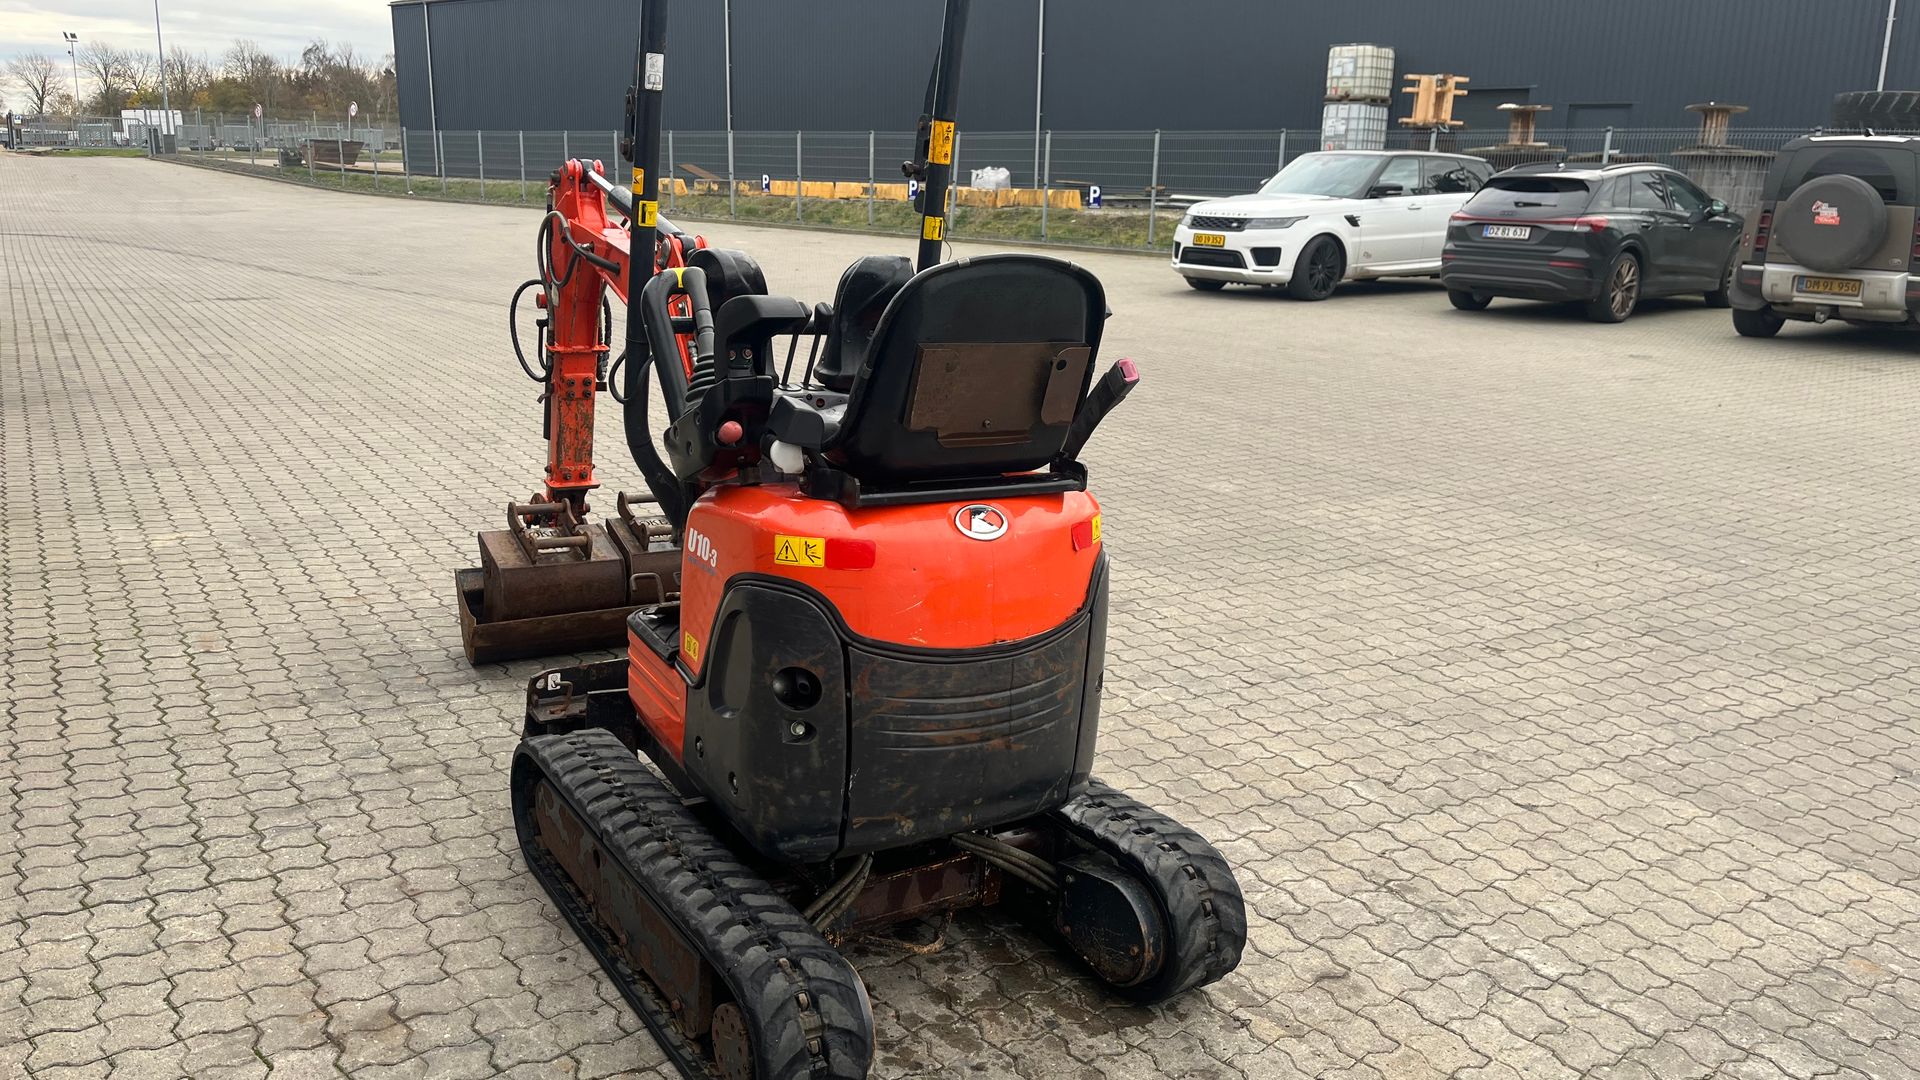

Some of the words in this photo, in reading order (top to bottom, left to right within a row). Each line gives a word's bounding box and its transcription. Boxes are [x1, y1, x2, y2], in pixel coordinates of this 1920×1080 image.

[762, 174, 770, 189] P
[908, 180, 918, 196] P
[1089, 185, 1101, 204] P
[1837, 281, 1857, 292] 956
